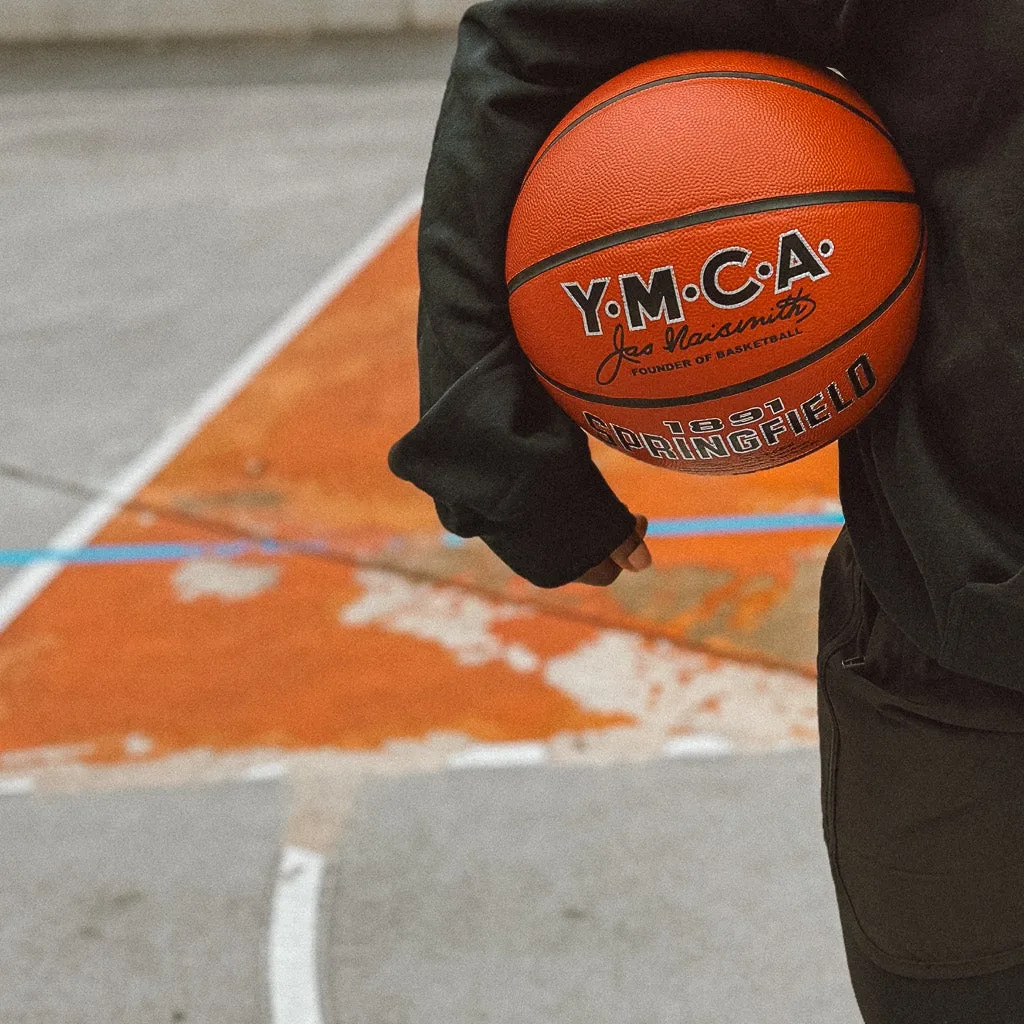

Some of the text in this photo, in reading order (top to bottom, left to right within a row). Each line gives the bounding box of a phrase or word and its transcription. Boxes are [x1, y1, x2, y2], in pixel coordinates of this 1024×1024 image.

[631, 328, 803, 376] FOUNDER OF BASKETBALL
[583, 353, 878, 460] SPRINGFIELD
[663, 397, 786, 435] 1891
